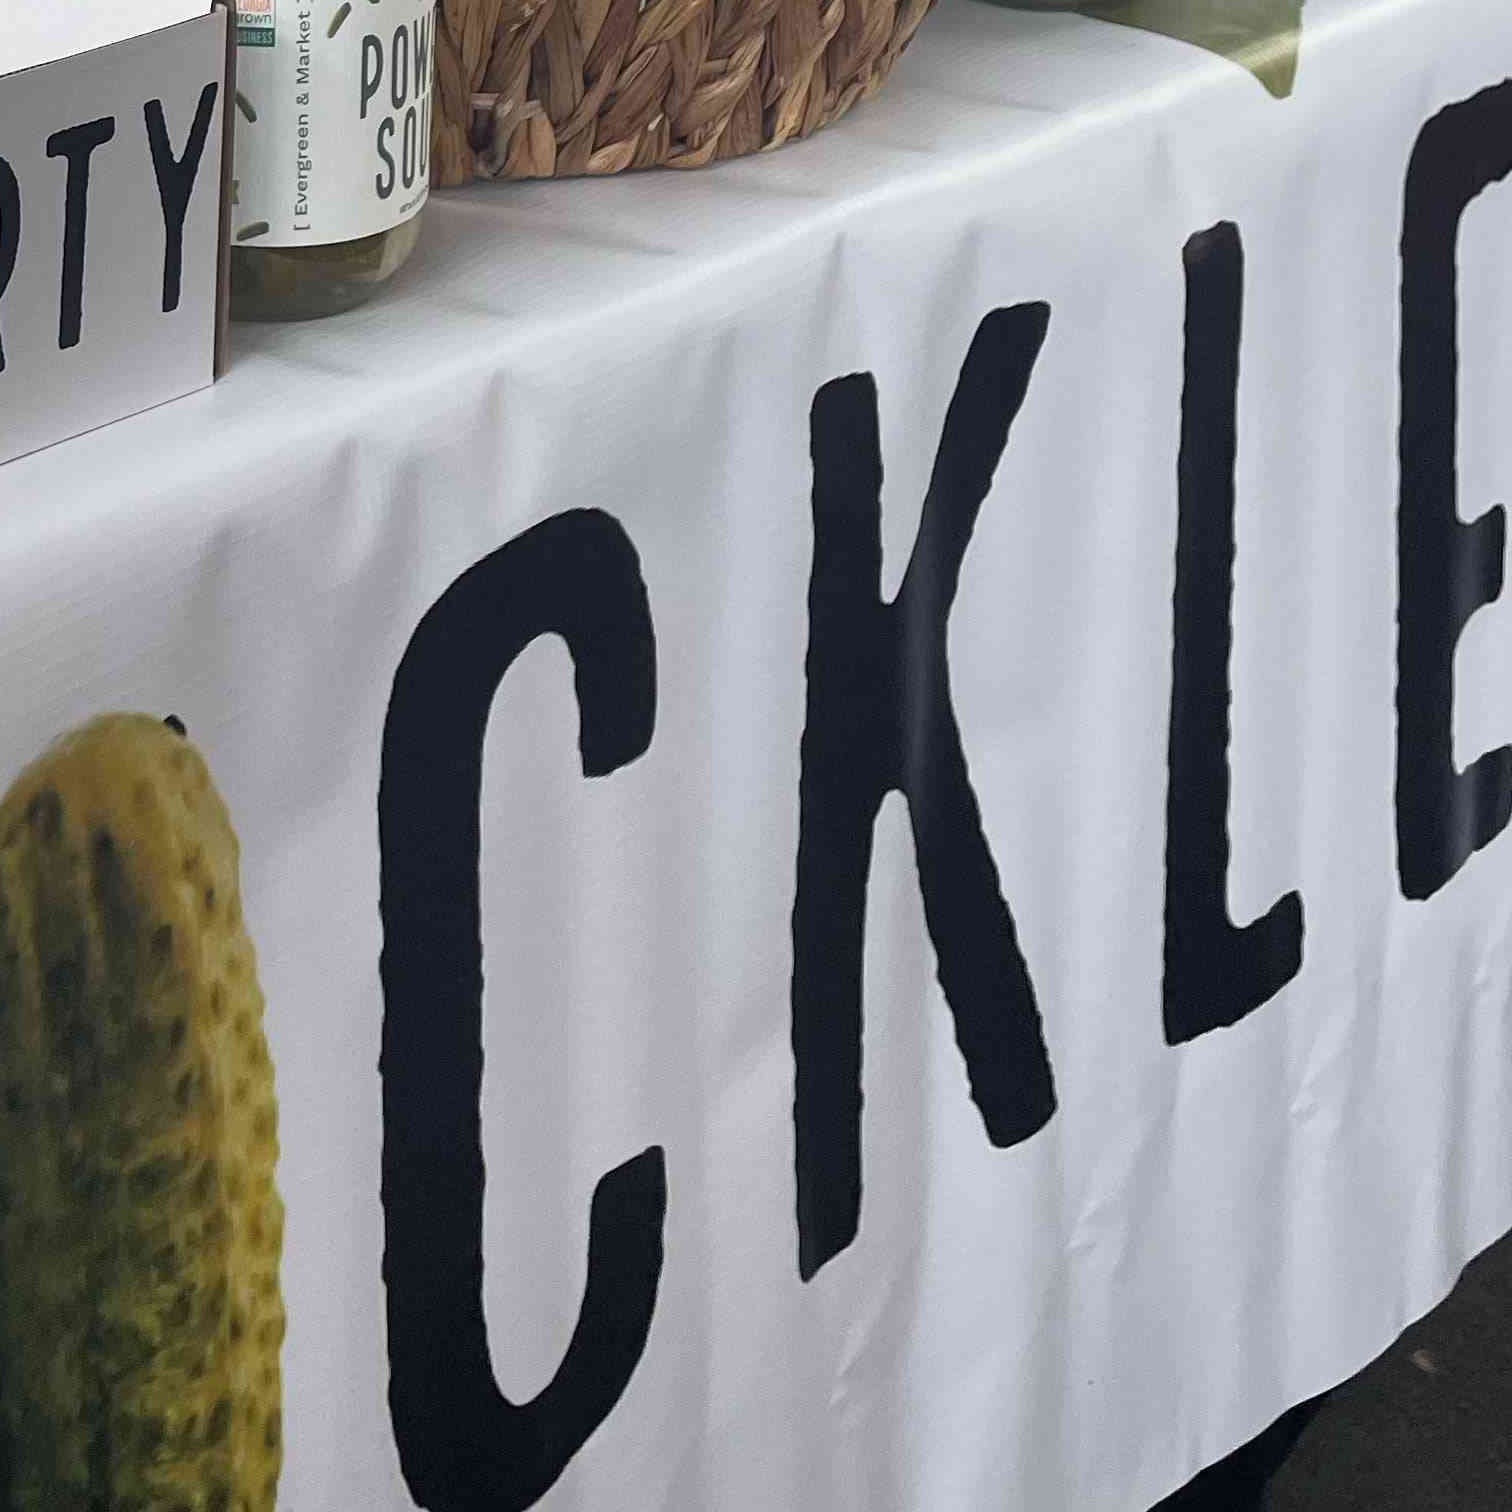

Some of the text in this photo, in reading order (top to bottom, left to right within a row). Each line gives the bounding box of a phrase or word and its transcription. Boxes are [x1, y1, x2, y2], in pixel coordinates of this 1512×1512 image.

[296, 11, 312, 84] Market
[296, 92, 310, 105] &
[295, 114, 312, 216] Evergreen
[375, 91, 431, 200] SOU
